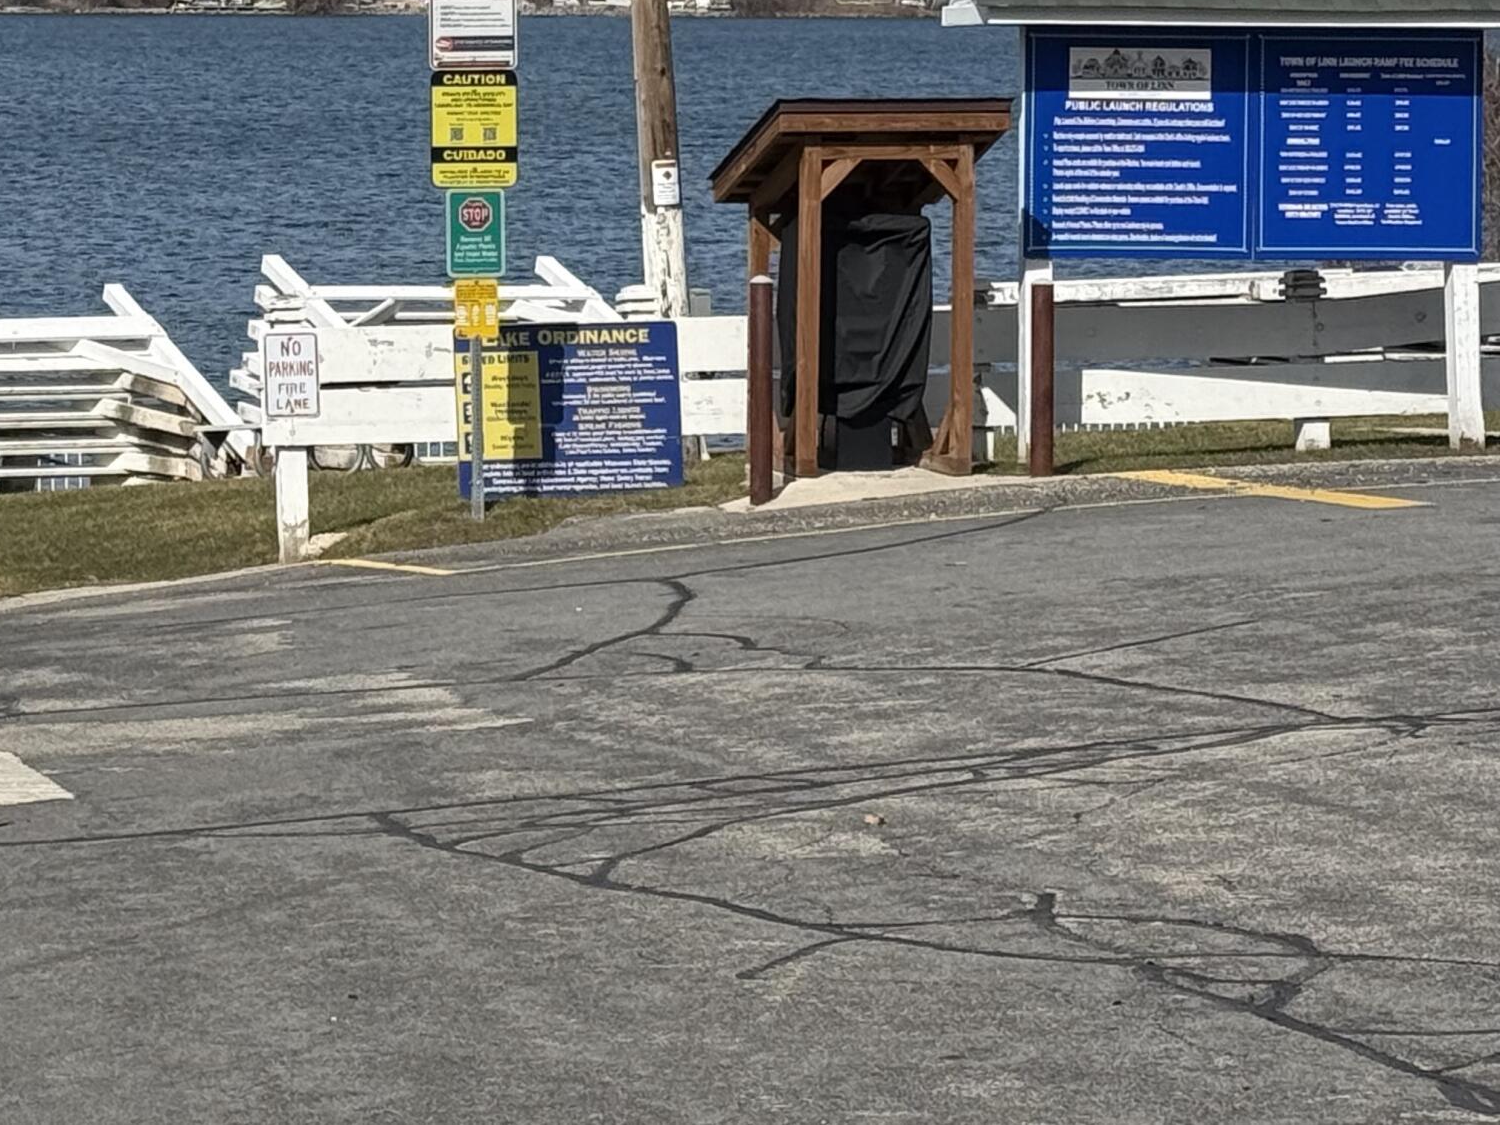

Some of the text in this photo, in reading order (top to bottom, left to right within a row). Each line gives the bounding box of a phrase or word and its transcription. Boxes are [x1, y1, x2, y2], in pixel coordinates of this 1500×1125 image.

[443, 74, 506, 85] CAUTION
[1105, 81, 1135, 90] TOWN
[1064, 101, 1214, 113] PUBLIC LAUNCH REGULATIONS
[443, 149, 506, 161] CUIDADO
[462, 208, 488, 221] STOP
[537, 328, 651, 345] ORDINANCE
[280, 340, 302, 357] NO
[269, 361, 314, 377] PARKING
[278, 382, 307, 395] FIRE
[276, 398, 311, 411] LANE
